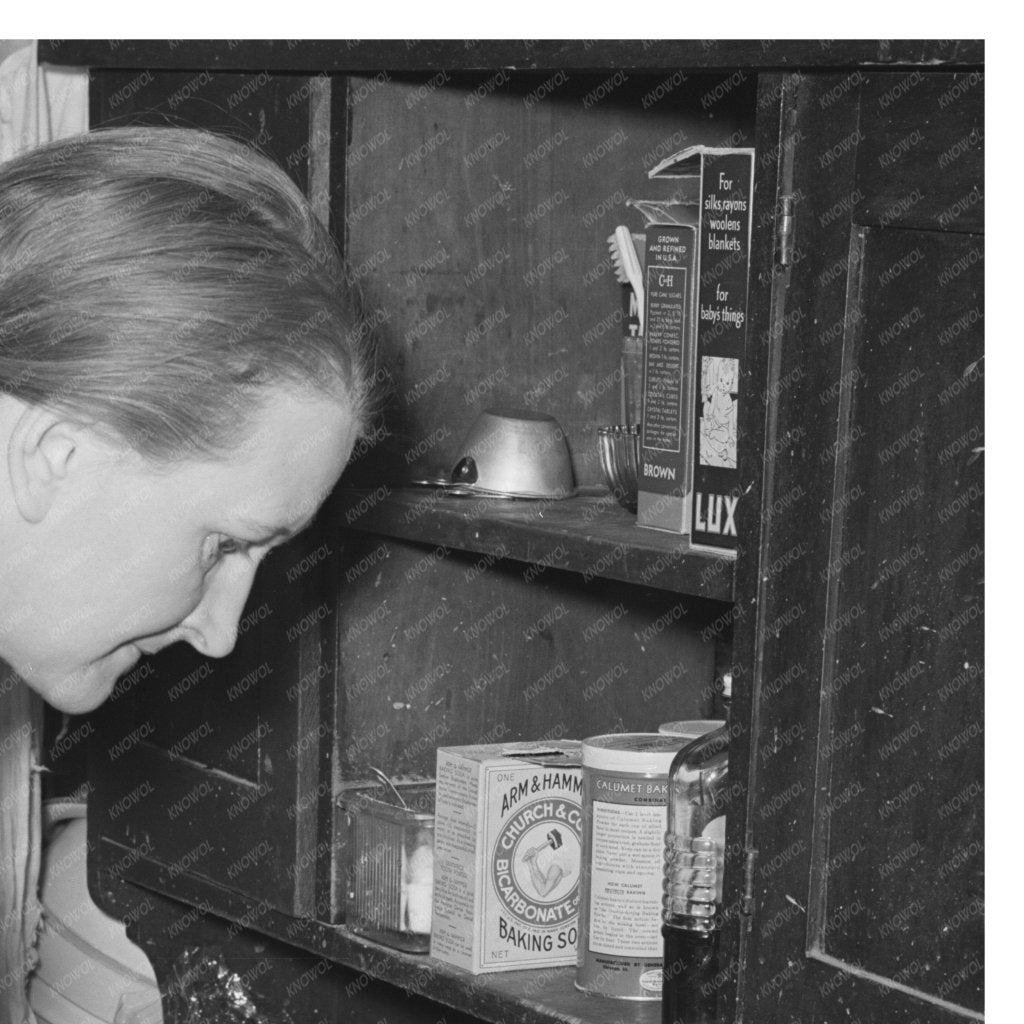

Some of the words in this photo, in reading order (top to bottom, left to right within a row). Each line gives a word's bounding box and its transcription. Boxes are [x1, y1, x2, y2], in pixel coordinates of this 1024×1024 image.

[719, 172, 733, 190] For
[709, 214, 741, 231] woolens
[657, 235, 679, 243] GROWN
[708, 233, 741, 251] blankets
[649, 244, 661, 253] AND
[662, 245, 687, 253] REFINED
[716, 283, 729, 301] for
[701, 304, 721, 325] baby's
[721, 306, 745, 328] things
[643, 463, 676, 481] BROWN
[695, 492, 738, 537] LUX
[497, 773, 515, 782] ONE
[596, 780, 642, 793] CALUMET
[501, 779, 528, 818] ARM
[531, 775, 541, 793] &
[501, 803, 554, 849] CHURCH
[556, 804, 567, 820] &
[496, 859, 575, 922] BICARBONATE
[499, 915, 553, 952] BAKING
[491, 950, 509, 960] NET
